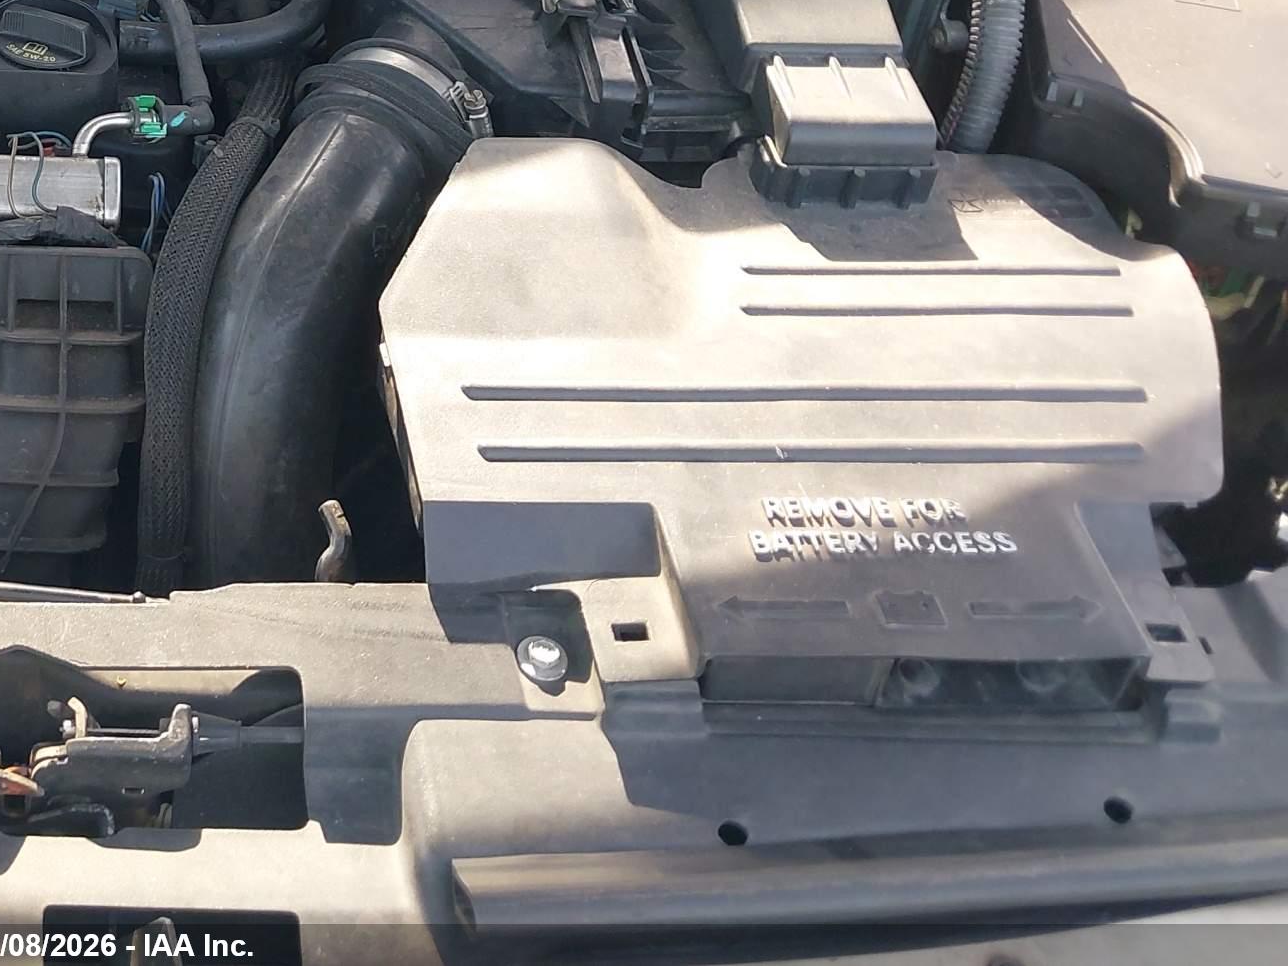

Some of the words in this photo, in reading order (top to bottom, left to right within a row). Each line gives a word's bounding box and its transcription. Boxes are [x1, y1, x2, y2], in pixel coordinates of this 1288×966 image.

[6, 43, 24, 55] SAE
[22, 53, 56, 62] 5W-20
[761, 496, 897, 527] REMOVE
[899, 497, 966, 526] FOR
[749, 530, 880, 561] BATTERY
[893, 531, 1019, 556] ACCESS
